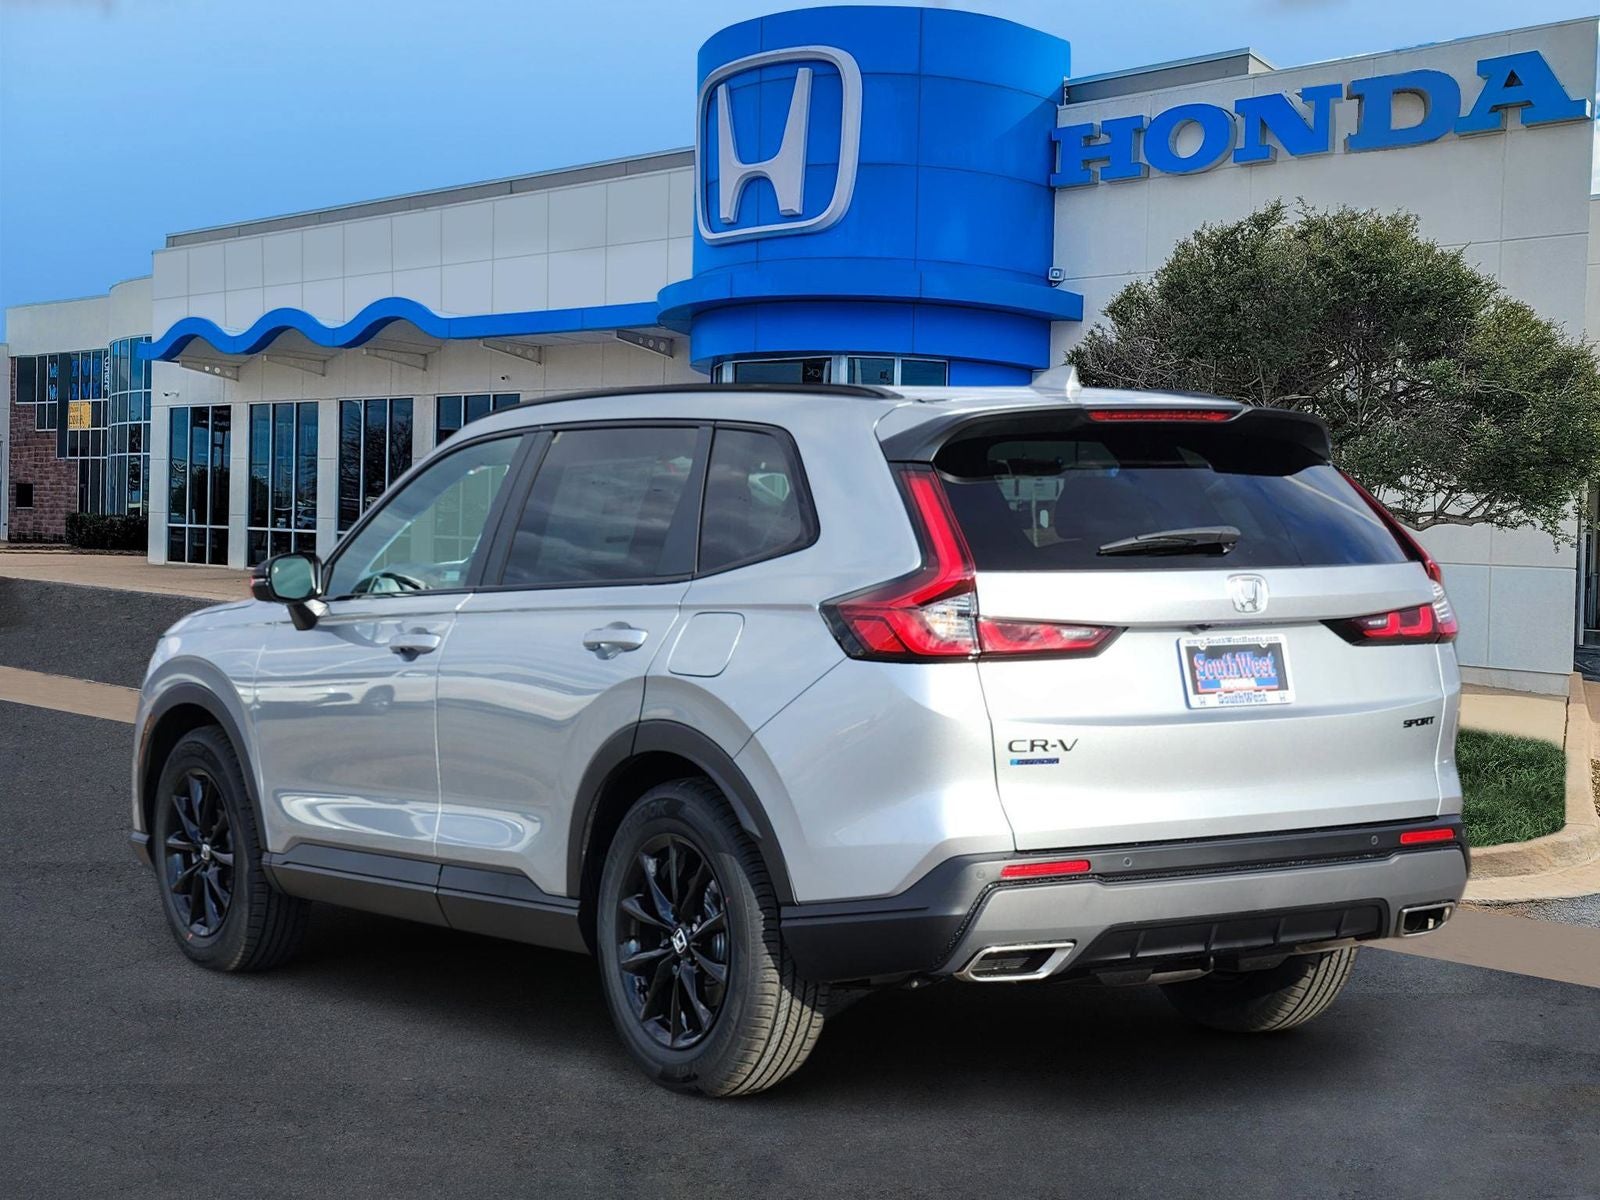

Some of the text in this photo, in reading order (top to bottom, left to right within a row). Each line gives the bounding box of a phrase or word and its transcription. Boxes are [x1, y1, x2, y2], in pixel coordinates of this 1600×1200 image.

[1050, 50, 1591, 189] HONDA
[1403, 715, 1436, 729] SPORT
[1007, 738, 1079, 753] CR-V
